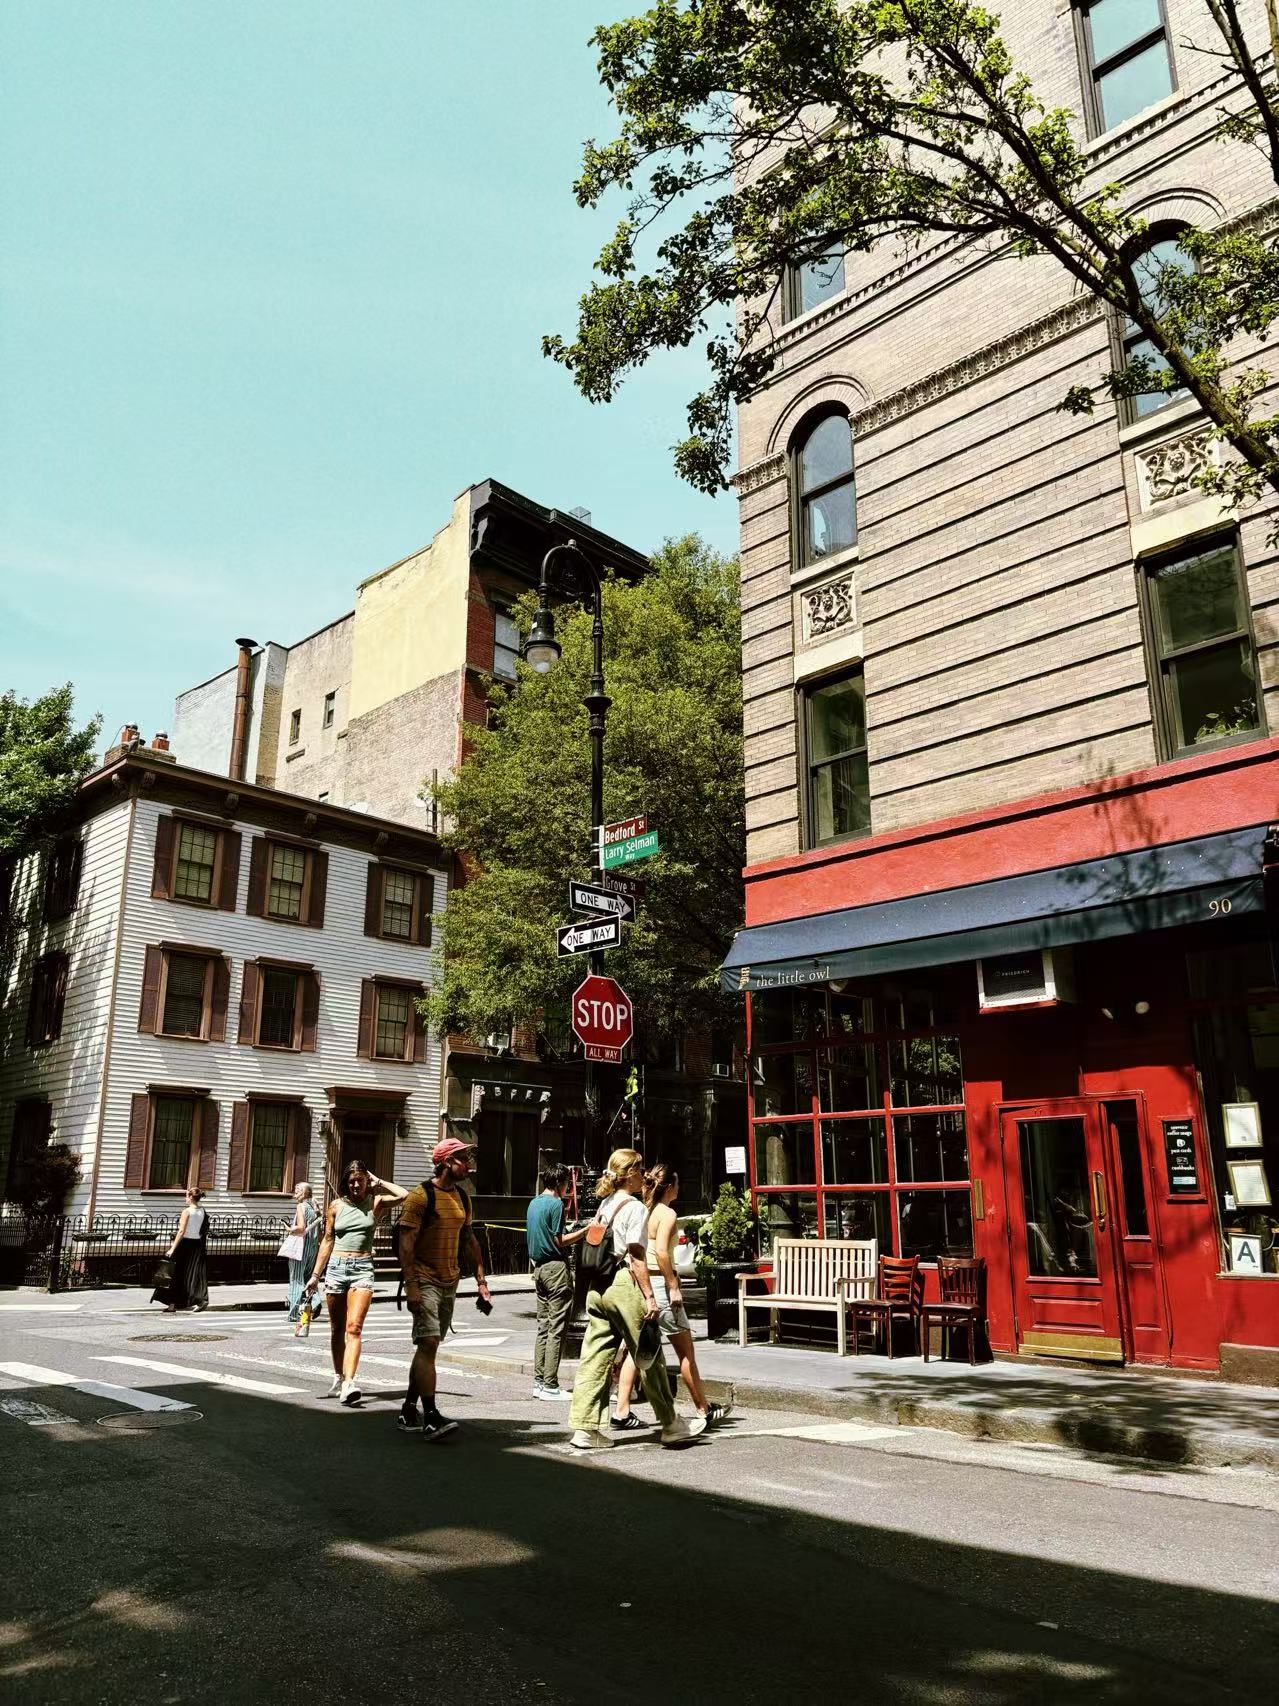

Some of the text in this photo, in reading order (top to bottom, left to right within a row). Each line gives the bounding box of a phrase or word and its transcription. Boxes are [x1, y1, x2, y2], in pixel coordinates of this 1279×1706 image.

[605, 820, 644, 844] Bedford St
[605, 835, 655, 859] Larry Selman
[605, 875, 636, 893] Grove St
[580, 893, 626, 912] ONE WAY
[1208, 898, 1232, 917] 90
[566, 926, 611, 946] ONE WAY
[756, 966, 830, 987] the little owl
[577, 999, 628, 1031] STOP
[589, 1047, 618, 1059] ALL WAY
[1237, 1241, 1256, 1263] A
